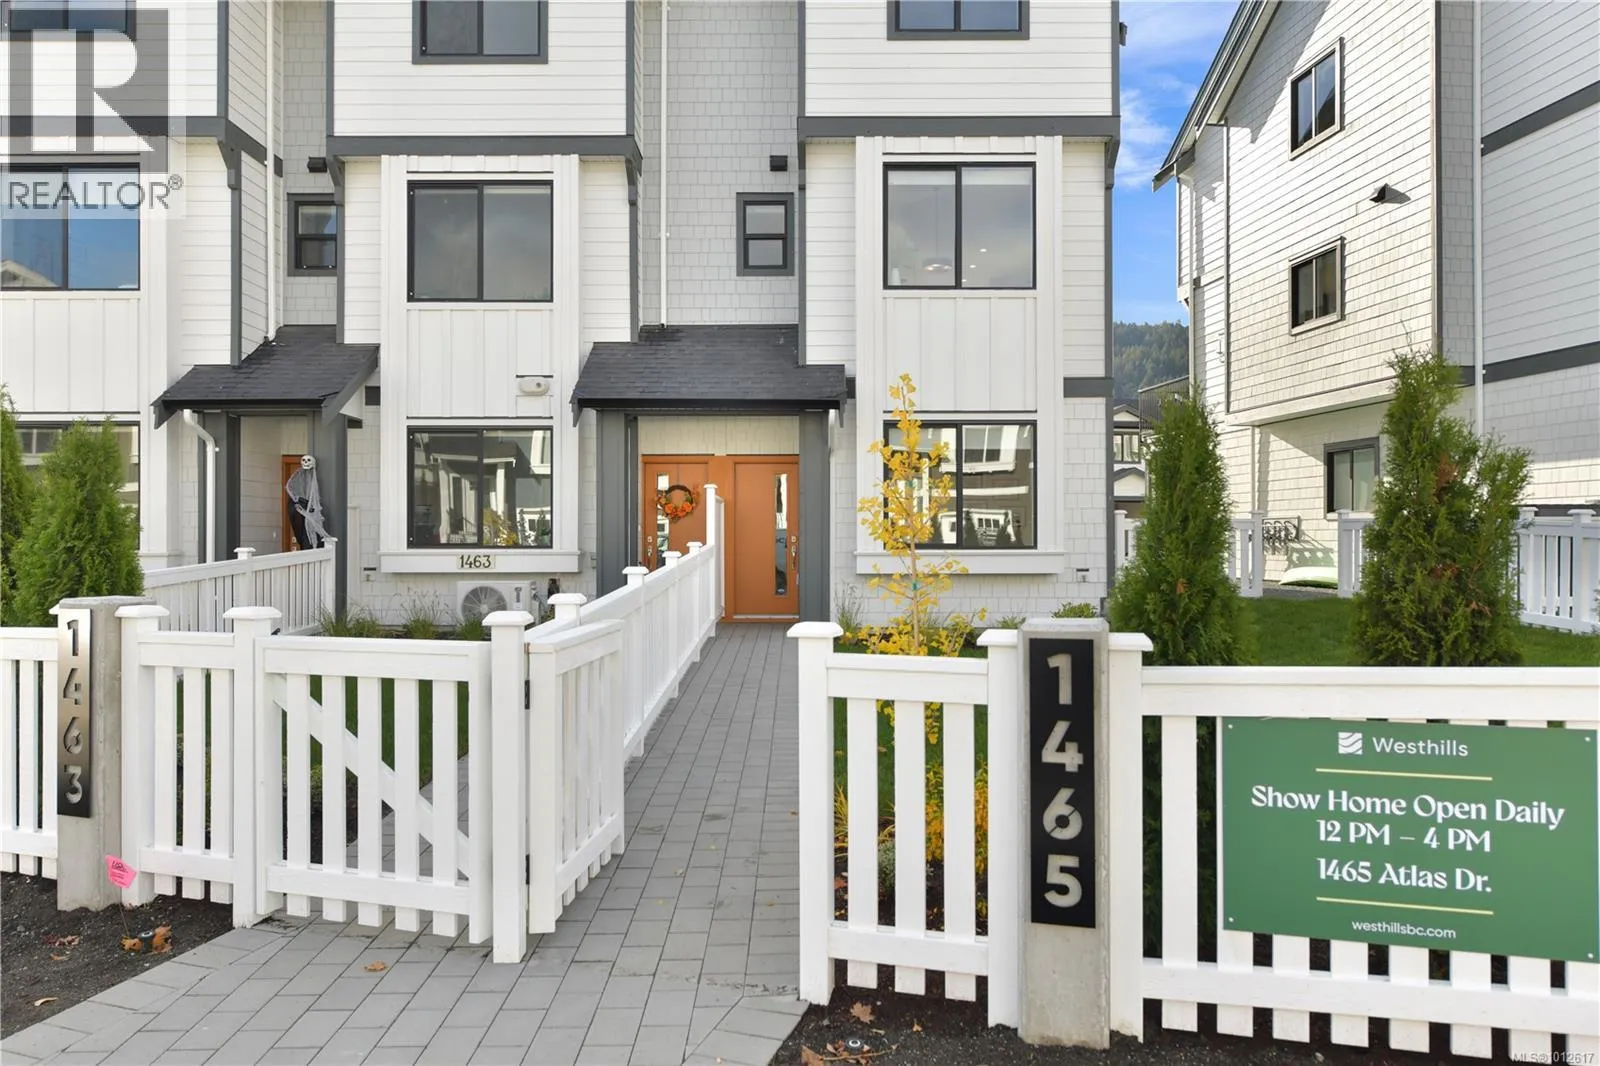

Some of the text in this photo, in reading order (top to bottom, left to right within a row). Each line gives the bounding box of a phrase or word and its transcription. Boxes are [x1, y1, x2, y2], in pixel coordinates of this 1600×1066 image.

[460, 554, 491, 568] 1463
[63, 619, 83, 804] 1463
[1372, 737, 1468, 757] Westhills
[1041, 653, 1083, 908] 1465
[1251, 785, 1565, 830] Show Home Open Daily
[1316, 819, 1342, 842] 12
[1349, 822, 1391, 846] PM
[1423, 827, 1441, 849] 4
[1448, 828, 1491, 852] PM
[1316, 858, 1492, 893] 1465 Atlas Dr.
[1351, 920, 1457, 939] westhillsbc.com
